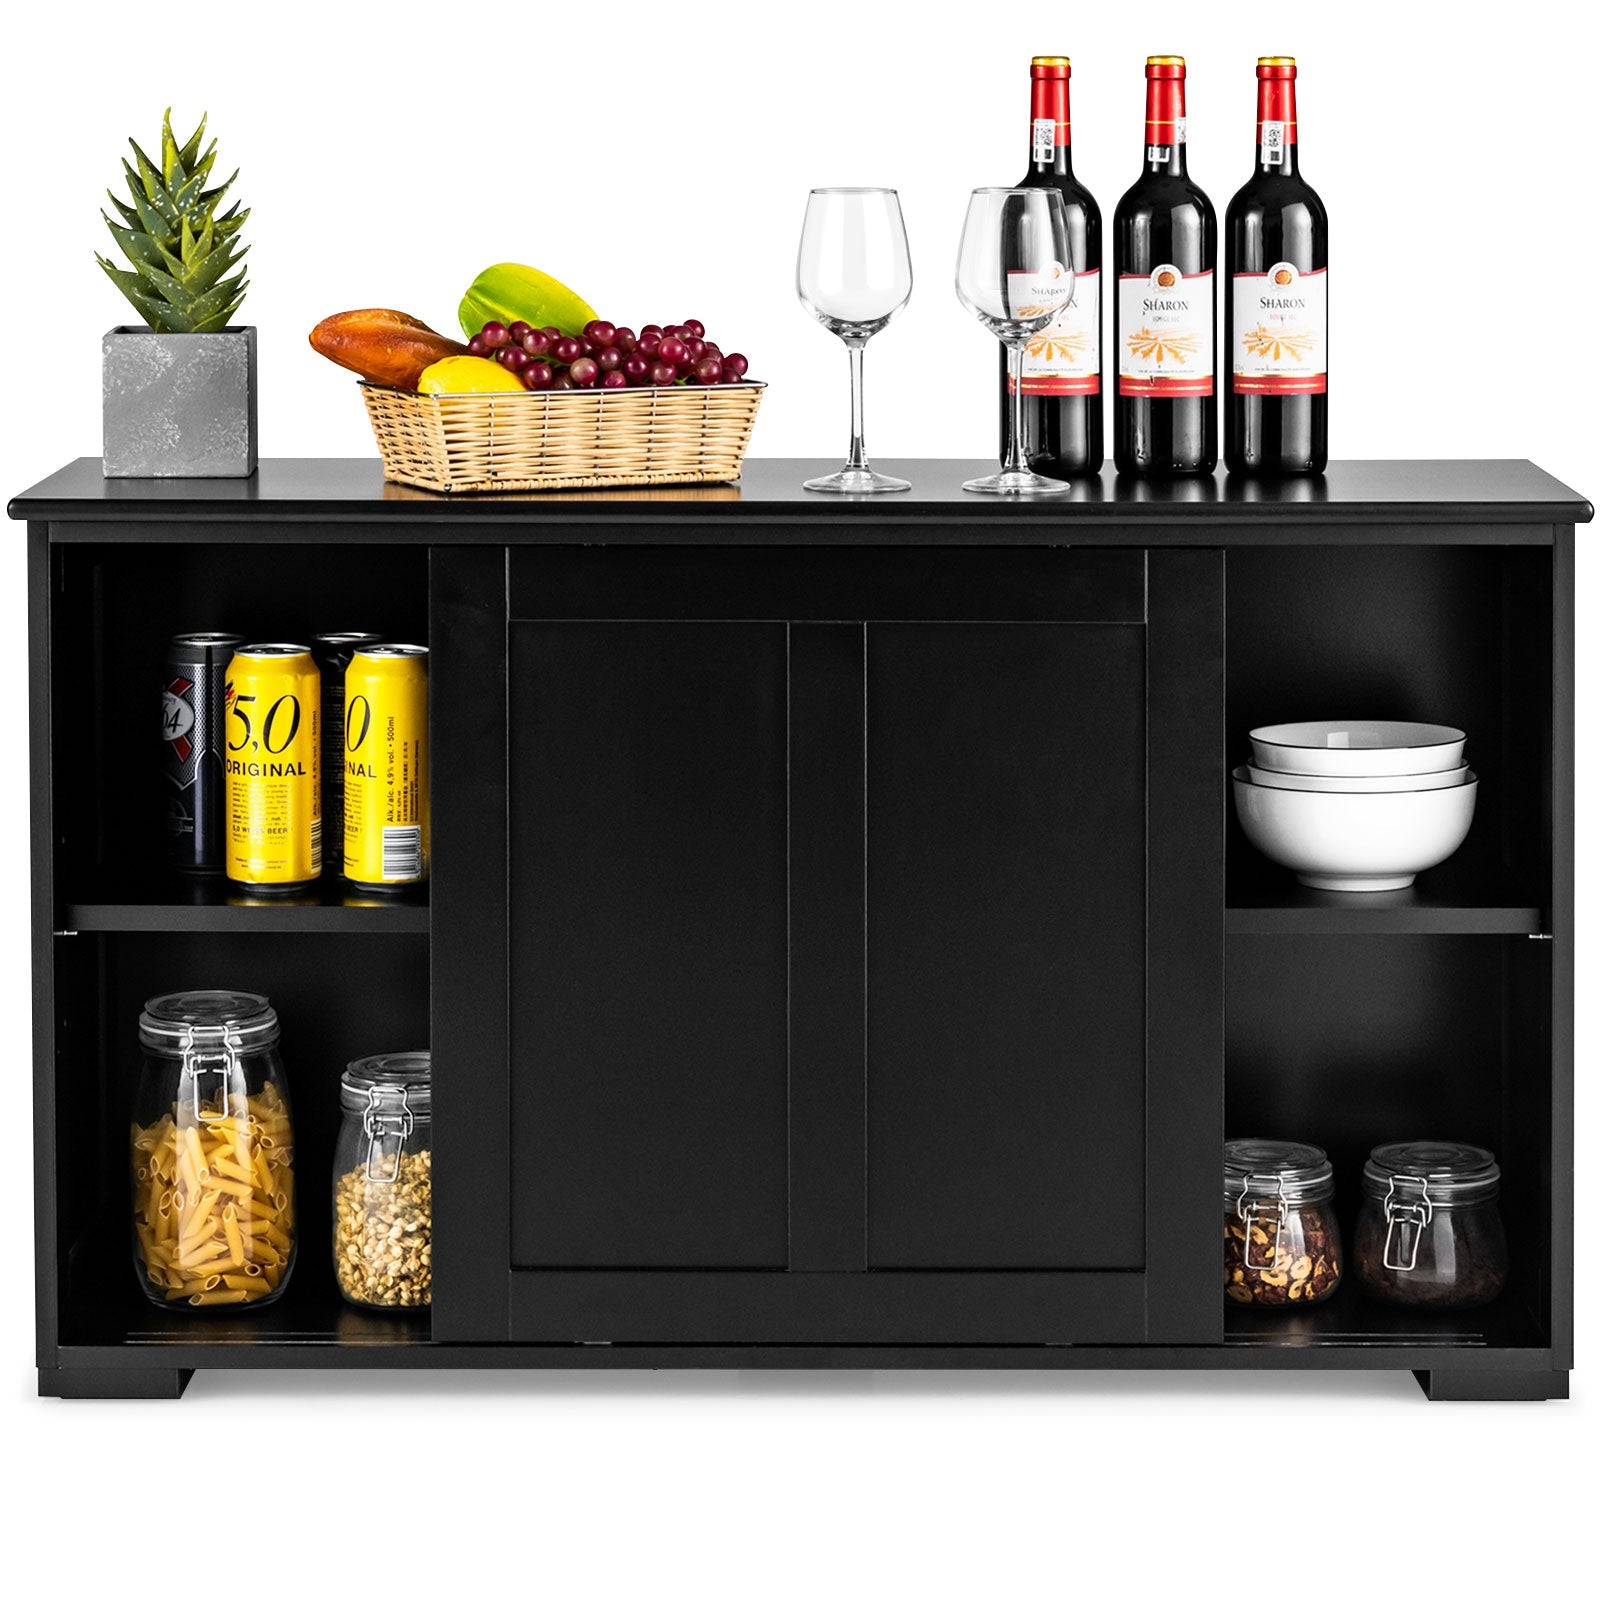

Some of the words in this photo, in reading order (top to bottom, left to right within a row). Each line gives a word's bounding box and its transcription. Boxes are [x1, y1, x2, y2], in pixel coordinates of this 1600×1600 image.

[1143, 298, 1189, 311] SHARON
[1259, 296, 1305, 309] SHARON
[228, 694, 301, 754] 5,0
[387, 716, 395, 742] 500ml
[226, 761, 306, 777] ORIGINAL
